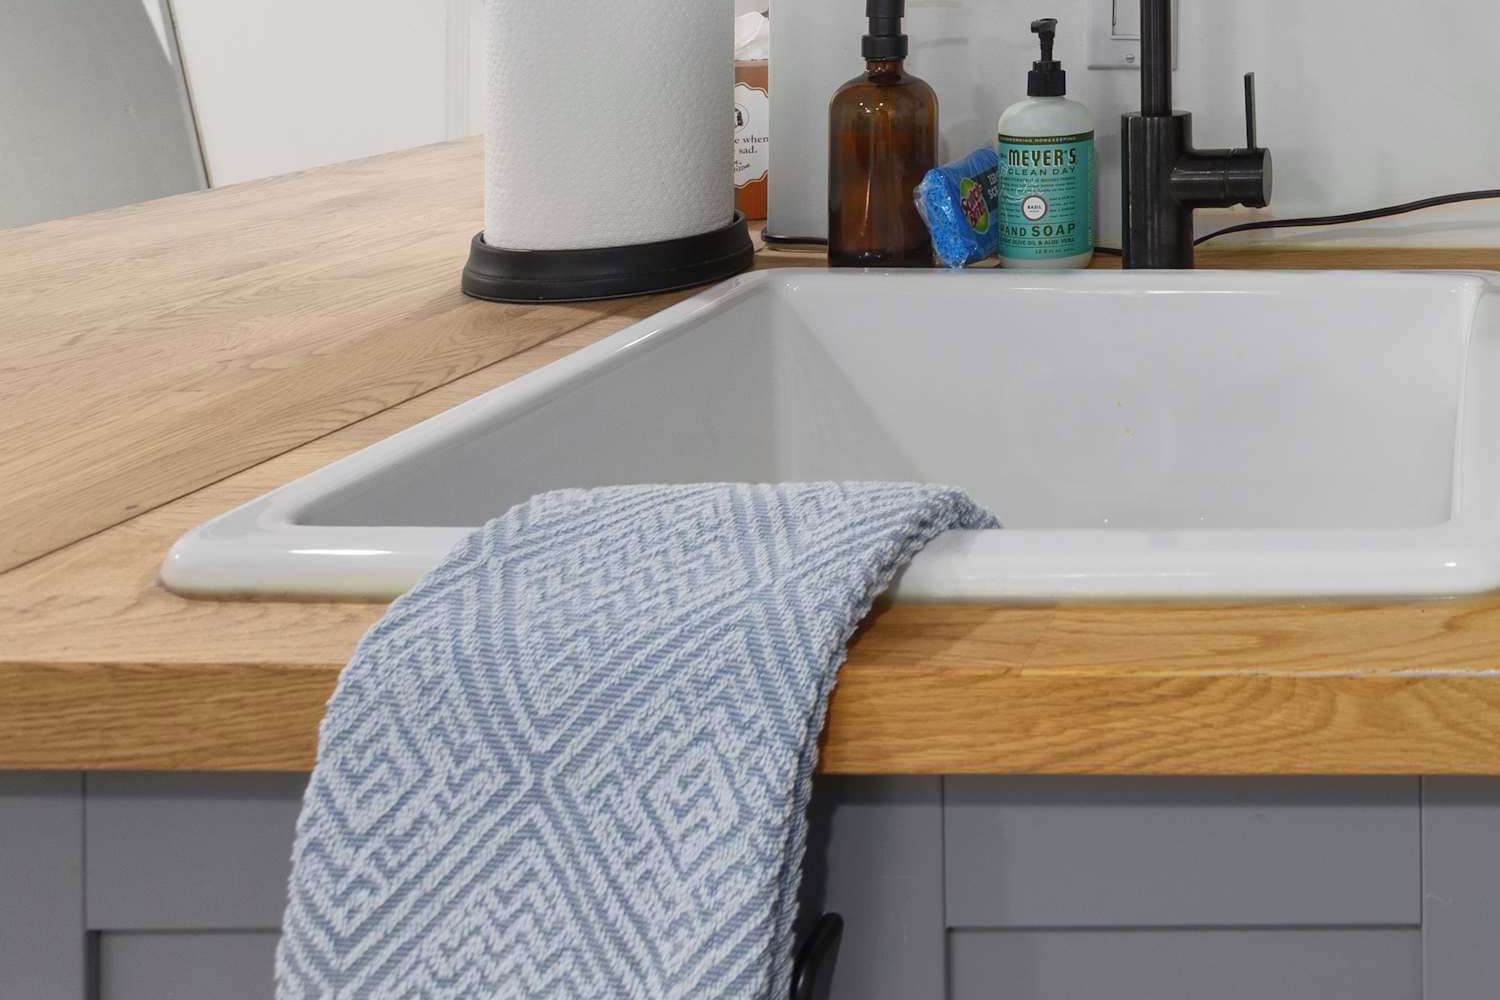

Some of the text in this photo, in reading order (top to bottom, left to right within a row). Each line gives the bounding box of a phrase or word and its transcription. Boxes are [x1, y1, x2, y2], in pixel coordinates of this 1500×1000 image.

[742, 134, 769, 143] when
[739, 145, 758, 154] sad.
[1008, 148, 1076, 167] MEYER'S
[1007, 167, 1076, 176] CLEAN DAY
[1031, 223, 1076, 237] SOAP
